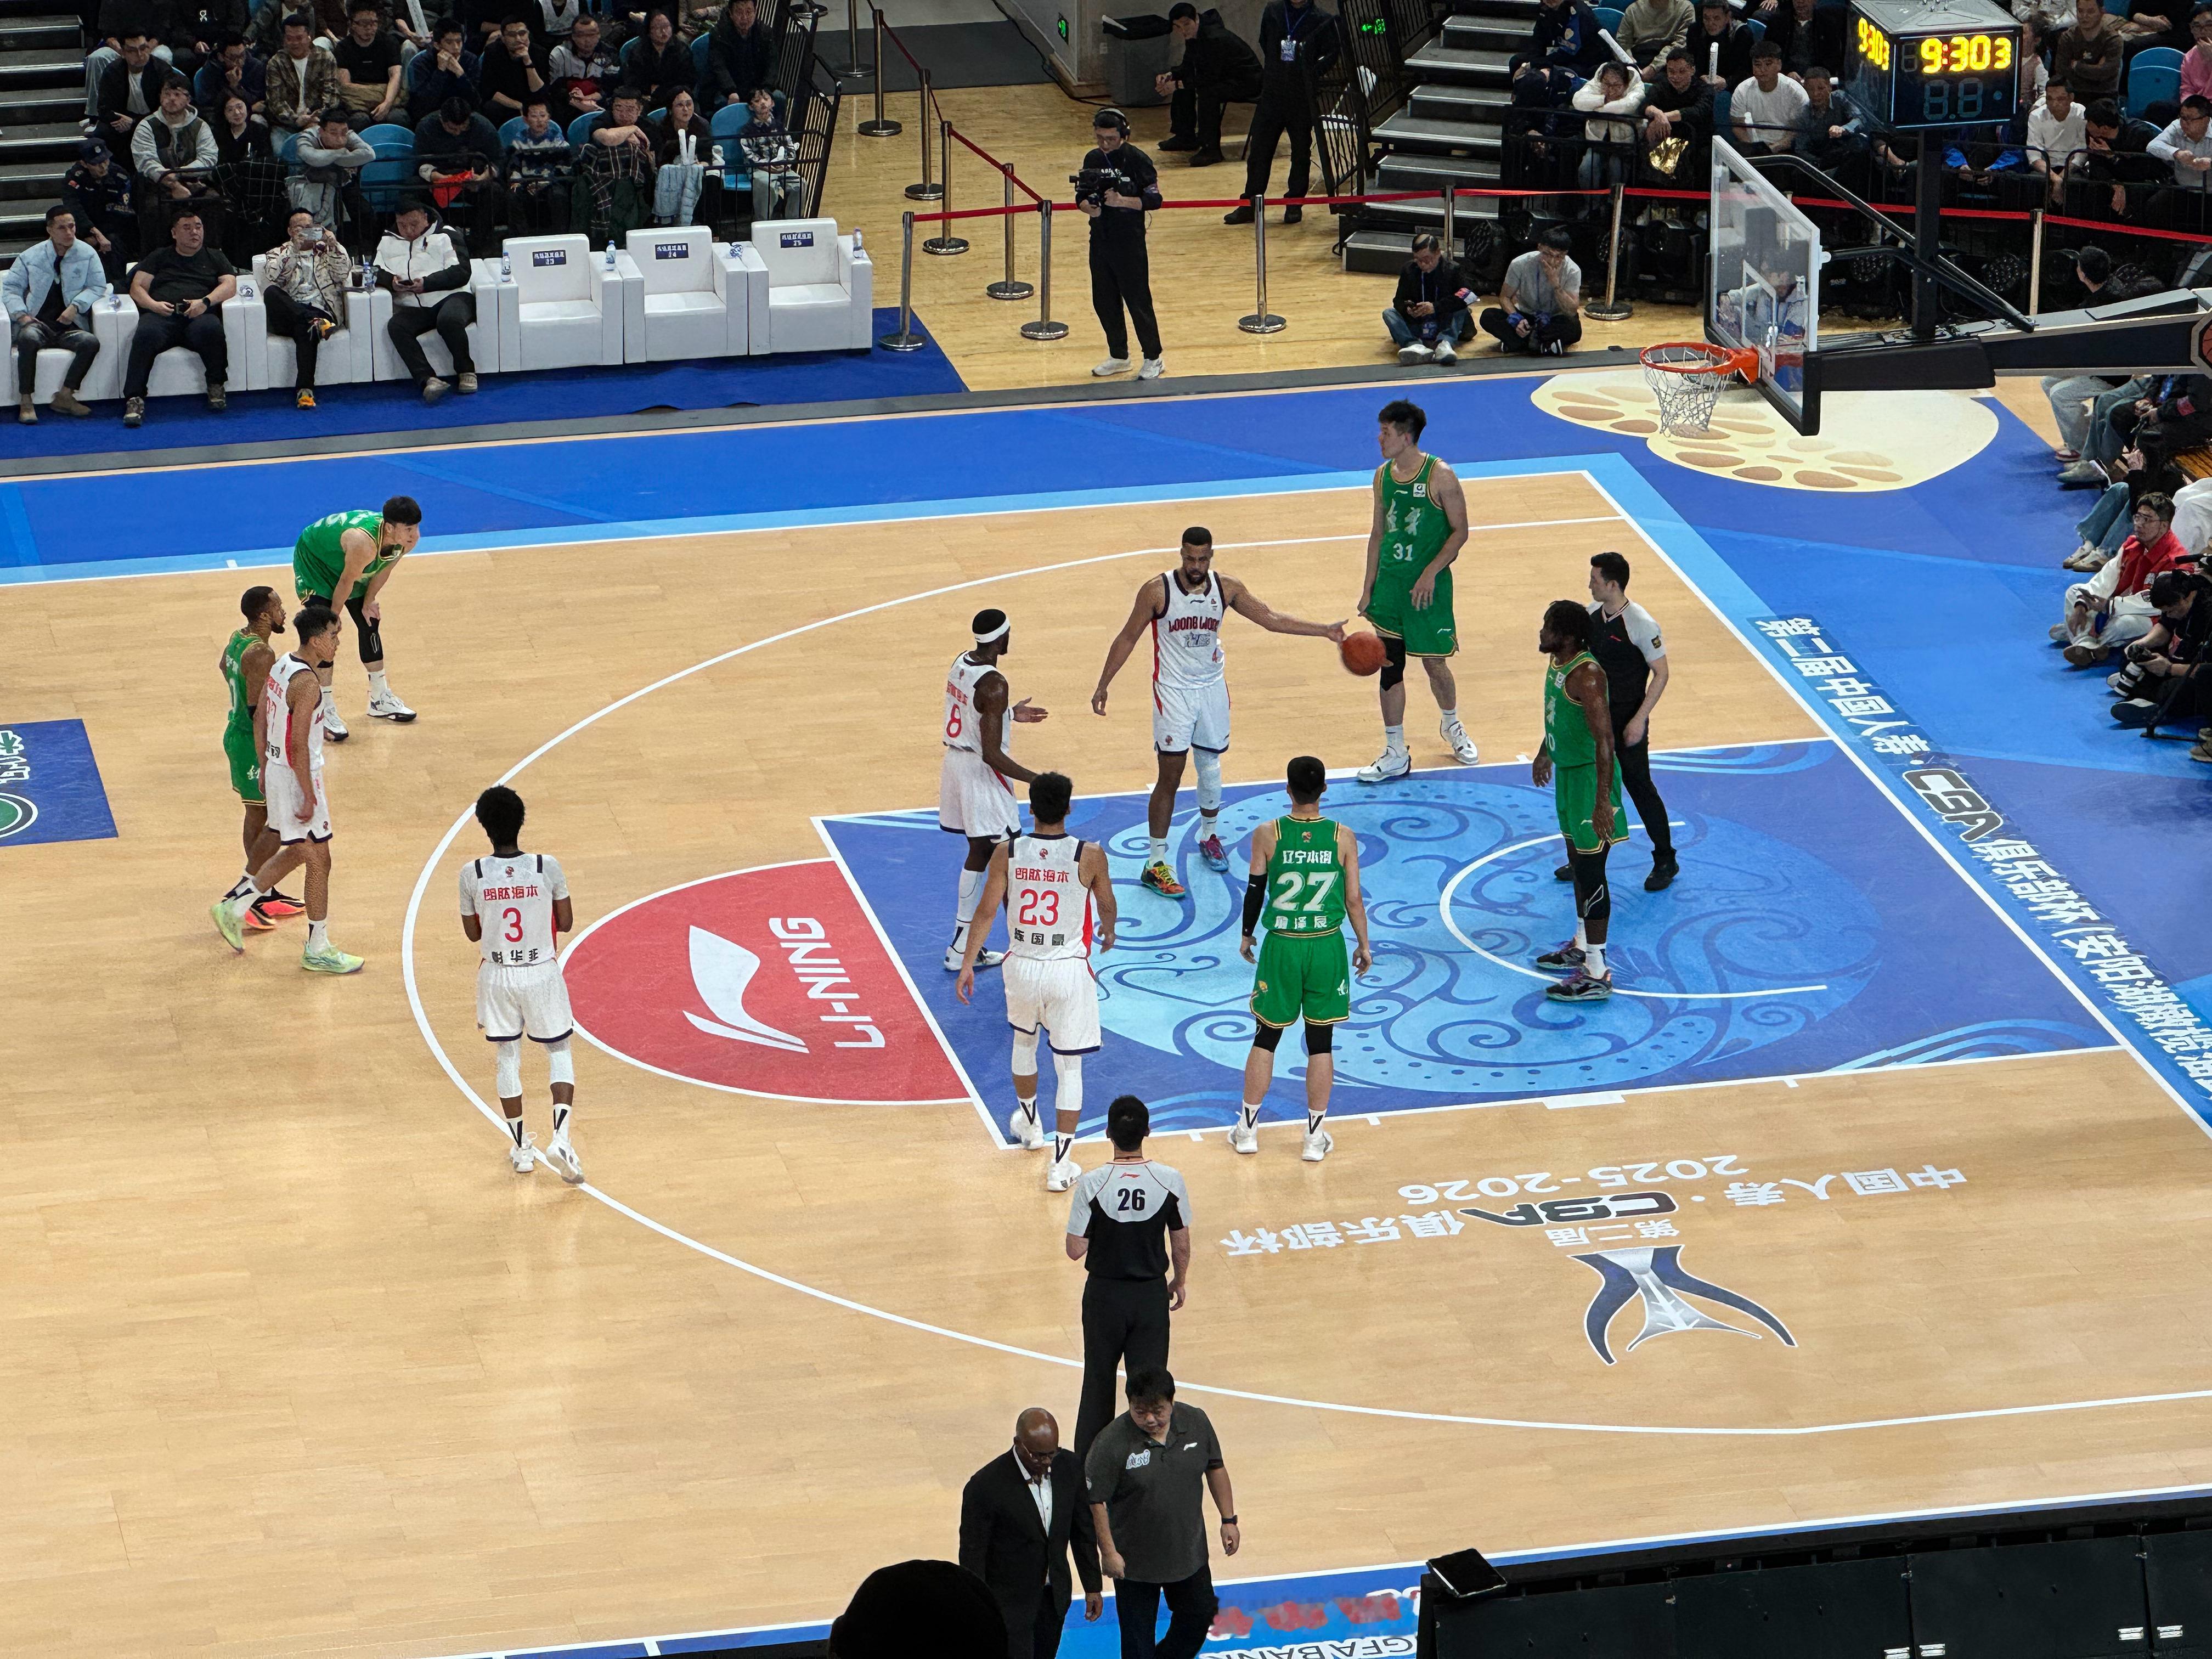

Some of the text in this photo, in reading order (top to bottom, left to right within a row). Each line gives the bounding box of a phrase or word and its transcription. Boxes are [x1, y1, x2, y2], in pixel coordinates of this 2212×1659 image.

[1393, 543, 1413, 561] 31
[946, 703, 962, 738] 8
[1019, 888, 1059, 926] 23
[1272, 871, 1339, 912] 27
[503, 907, 523, 943] 3
[769, 917, 885, 1048] LI-NING
[1398, 1154, 1750, 1205] 2025-2026
[1118, 1188, 1146, 1211] 26
[1547, 1218, 1680, 1246] 第二届
